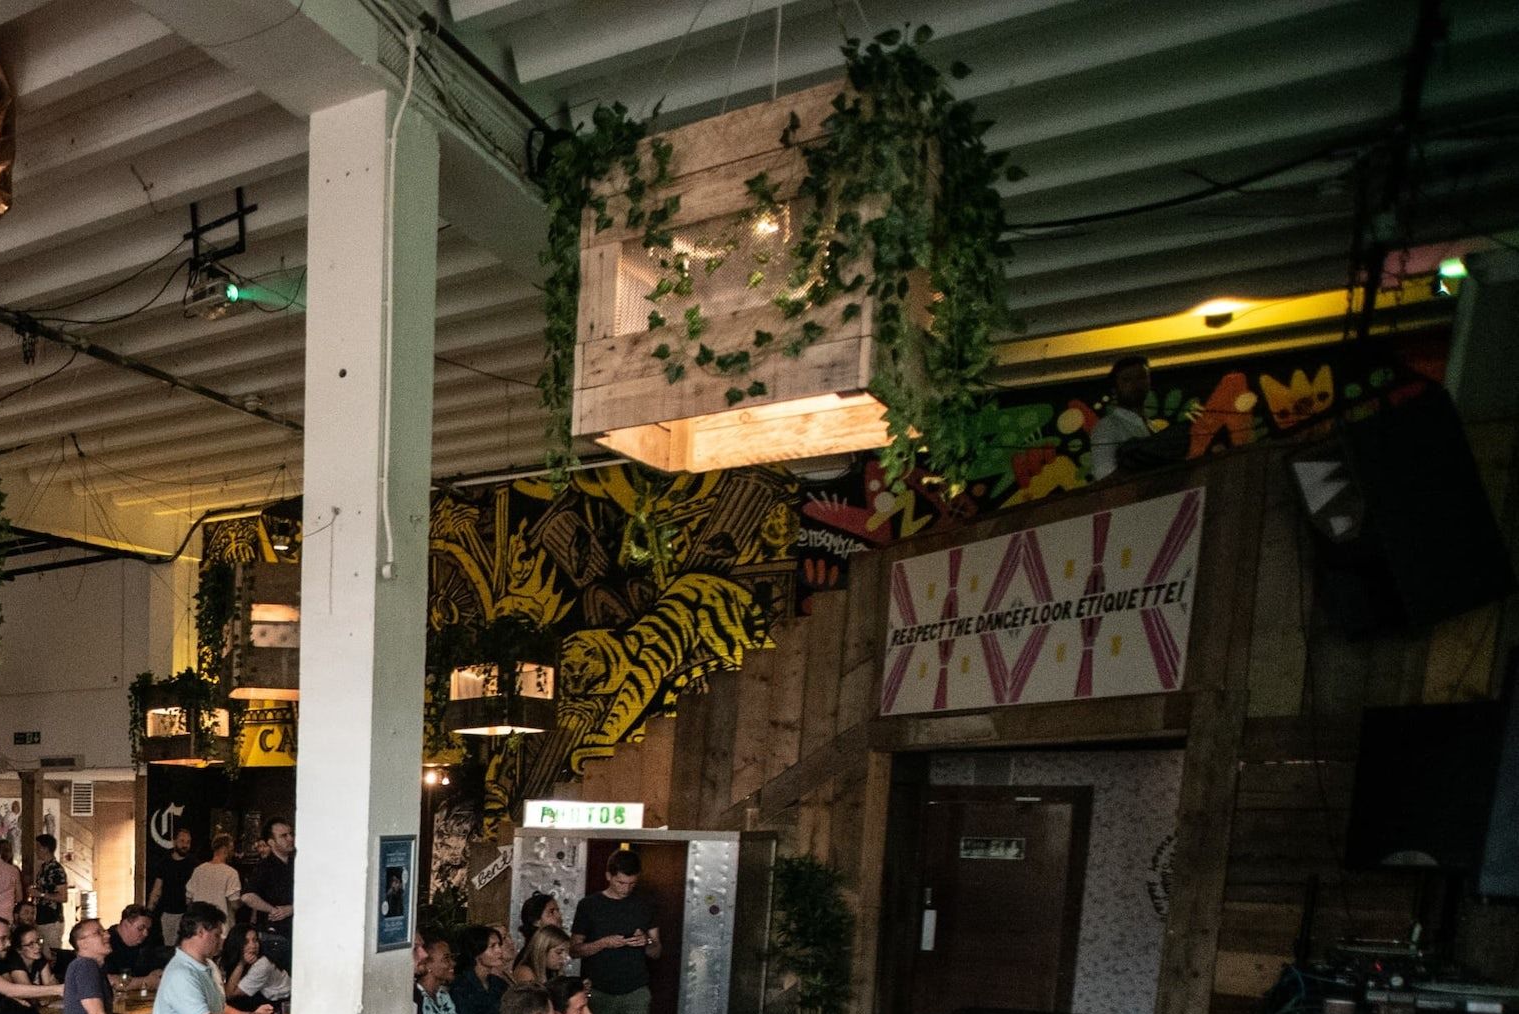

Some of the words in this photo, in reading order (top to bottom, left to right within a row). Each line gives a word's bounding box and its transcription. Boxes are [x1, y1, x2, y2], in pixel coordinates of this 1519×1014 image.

[891, 621, 946, 646] RESPECT
[947, 617, 975, 638] THE
[1075, 580, 1187, 618] ETIQUETTE!
